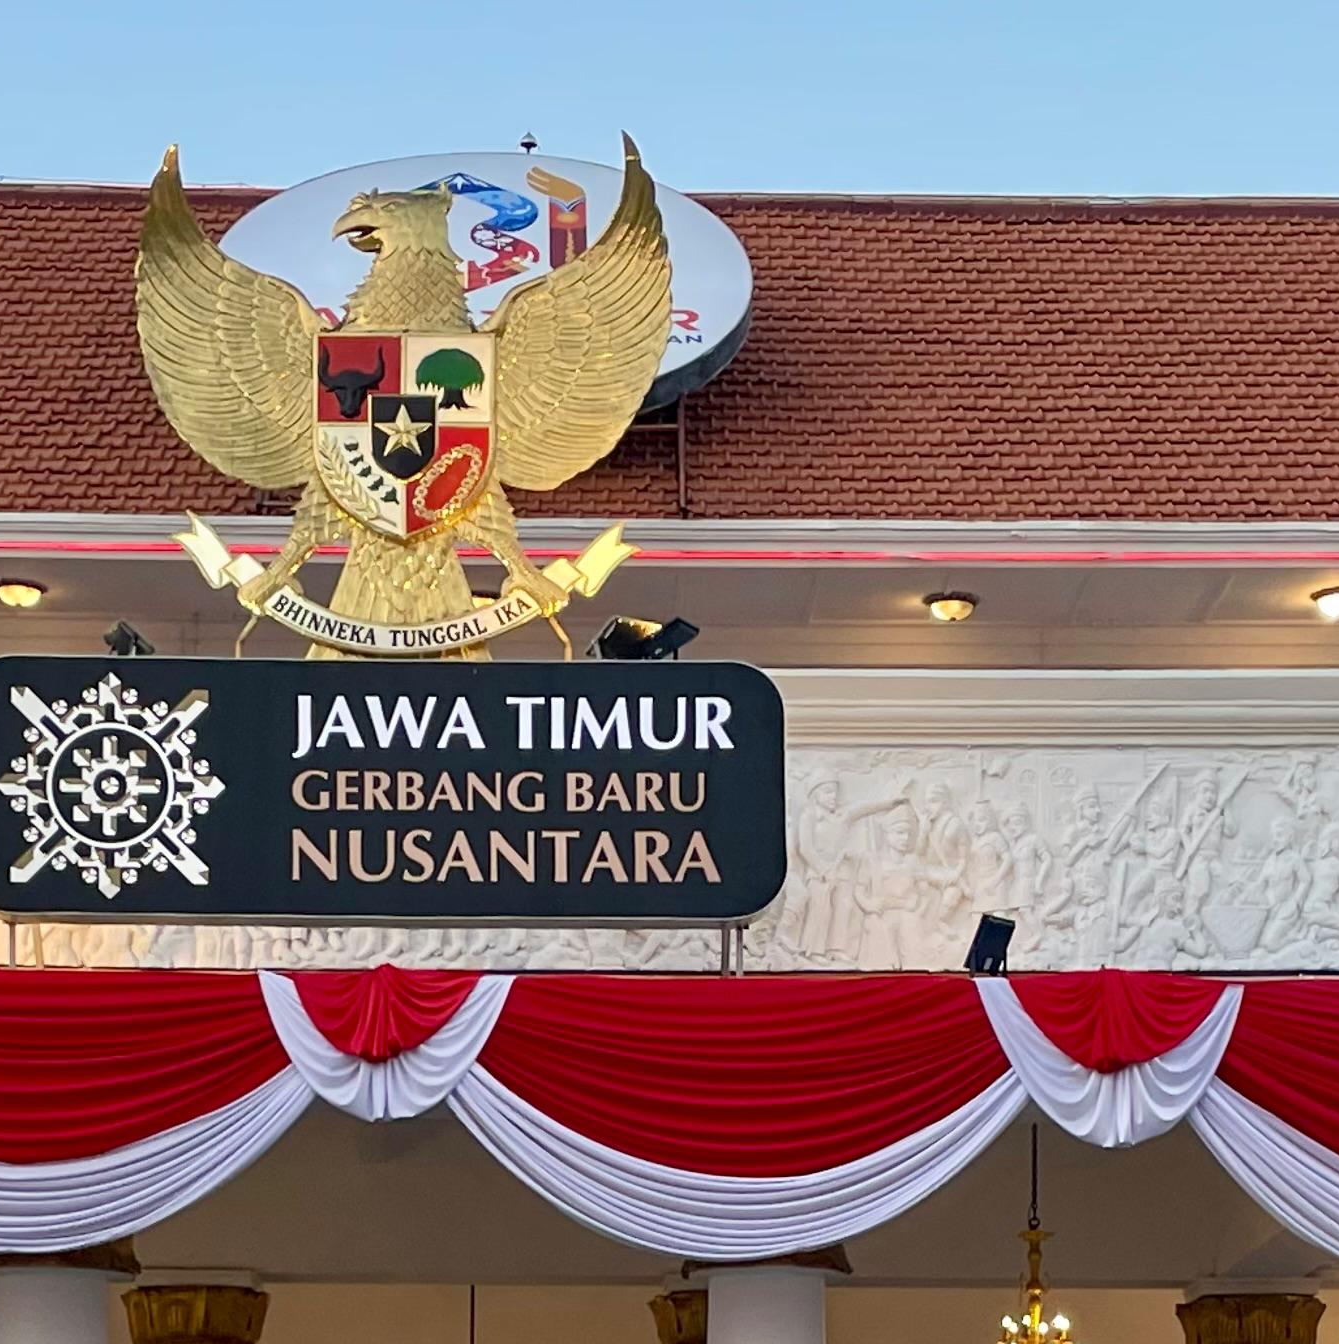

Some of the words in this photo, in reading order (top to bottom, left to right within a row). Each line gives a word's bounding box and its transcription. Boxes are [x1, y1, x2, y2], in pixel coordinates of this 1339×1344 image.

[272, 593, 377, 646] BHINNEKA
[389, 618, 488, 648] TUNGGAL
[494, 598, 532, 626] IKA
[292, 694, 487, 759] JAWA
[505, 696, 735, 751] TIMUR
[291, 770, 546, 813] GERBANG
[565, 771, 706, 813] BARU
[291, 828, 723, 884] NUSANTARA
